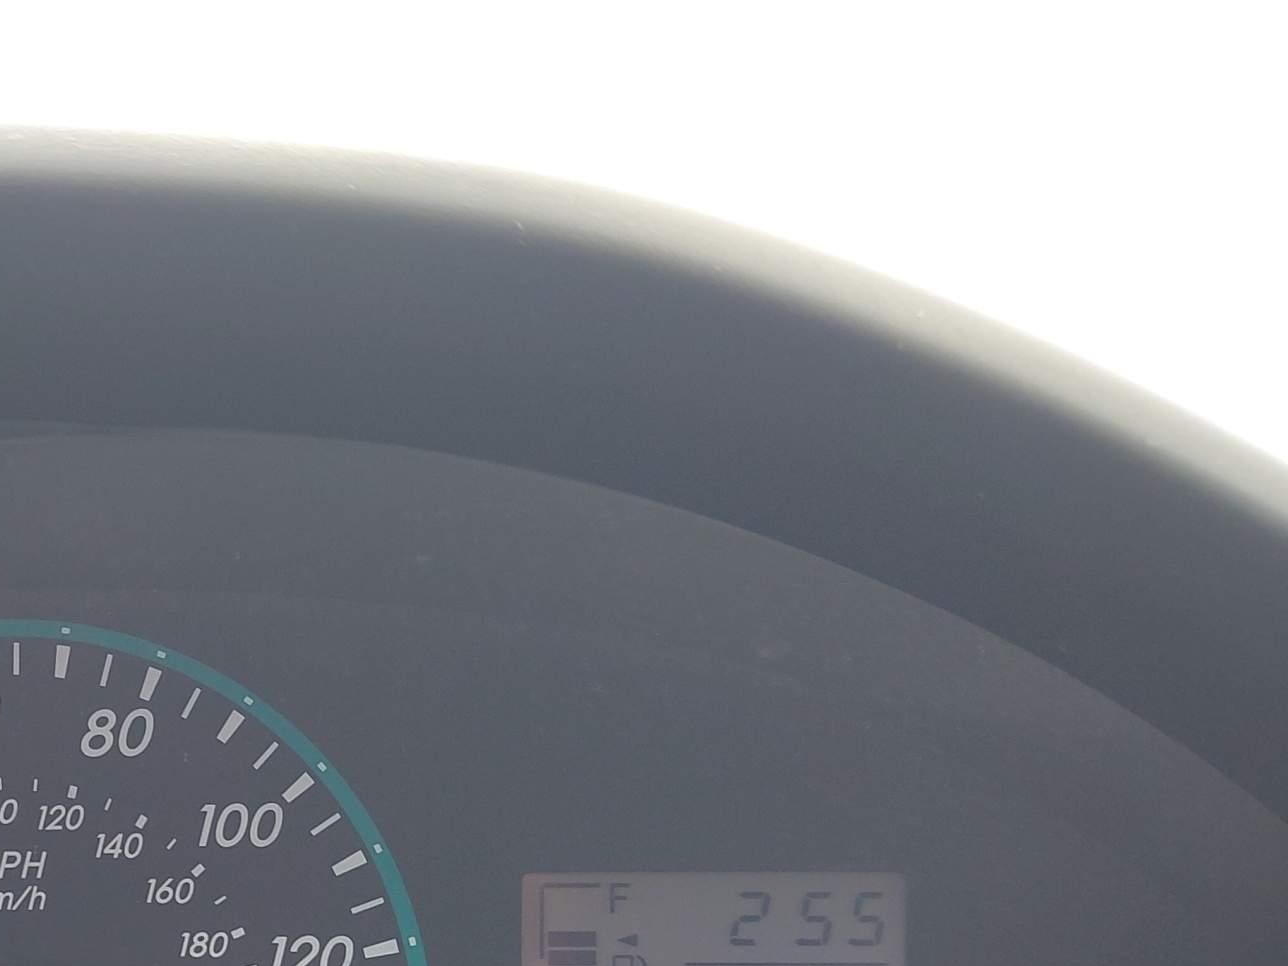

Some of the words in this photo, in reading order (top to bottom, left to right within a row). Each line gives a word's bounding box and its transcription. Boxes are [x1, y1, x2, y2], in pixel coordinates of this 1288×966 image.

[80, 708, 155, 758] 80
[38, 804, 85, 832] 120
[198, 802, 284, 848] 100
[95, 832, 144, 859] 140
[145, 878, 194, 905] 160
[610, 884, 630, 913] F
[180, 932, 229, 958] 180
